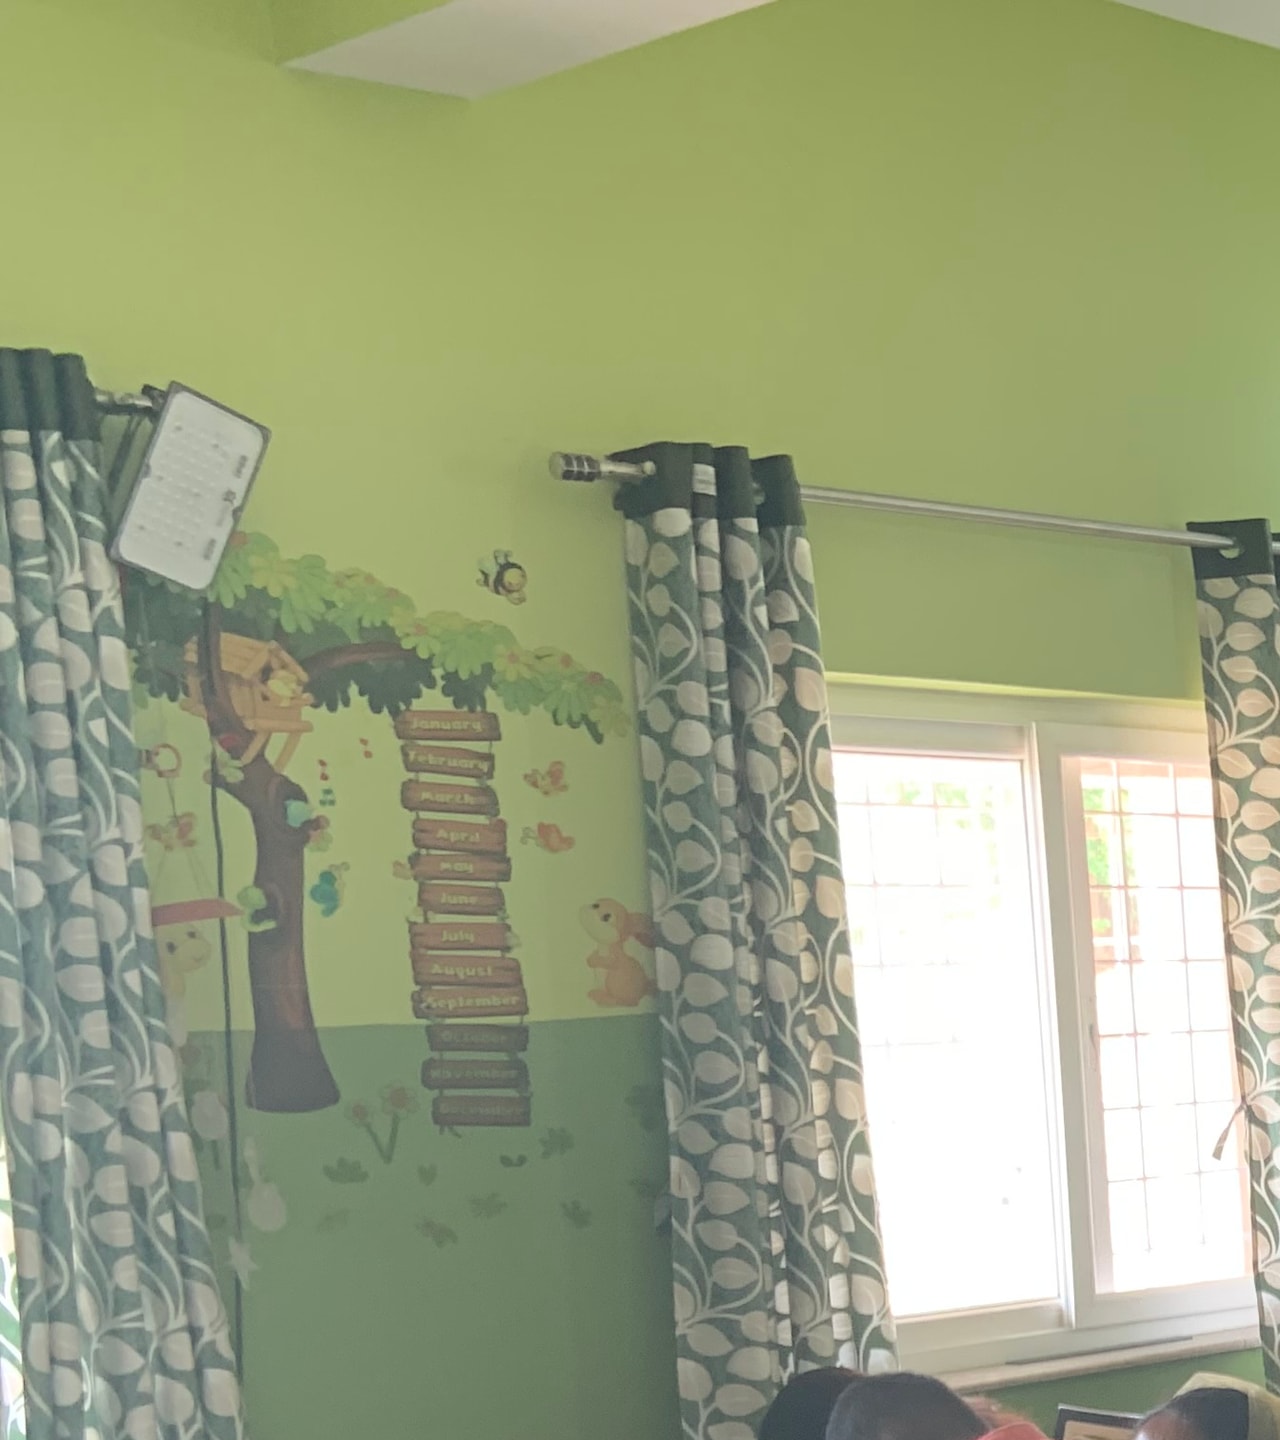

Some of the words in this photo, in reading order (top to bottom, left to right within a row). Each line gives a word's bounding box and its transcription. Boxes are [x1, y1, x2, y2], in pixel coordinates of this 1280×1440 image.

[411, 718, 482, 732] January
[408, 751, 489, 769] February
[436, 828, 480, 843] April
[439, 862, 474, 873] May
[440, 892, 478, 905] June
[441, 929, 475, 943] July
[431, 964, 493, 979] August
[428, 995, 518, 1010] September
